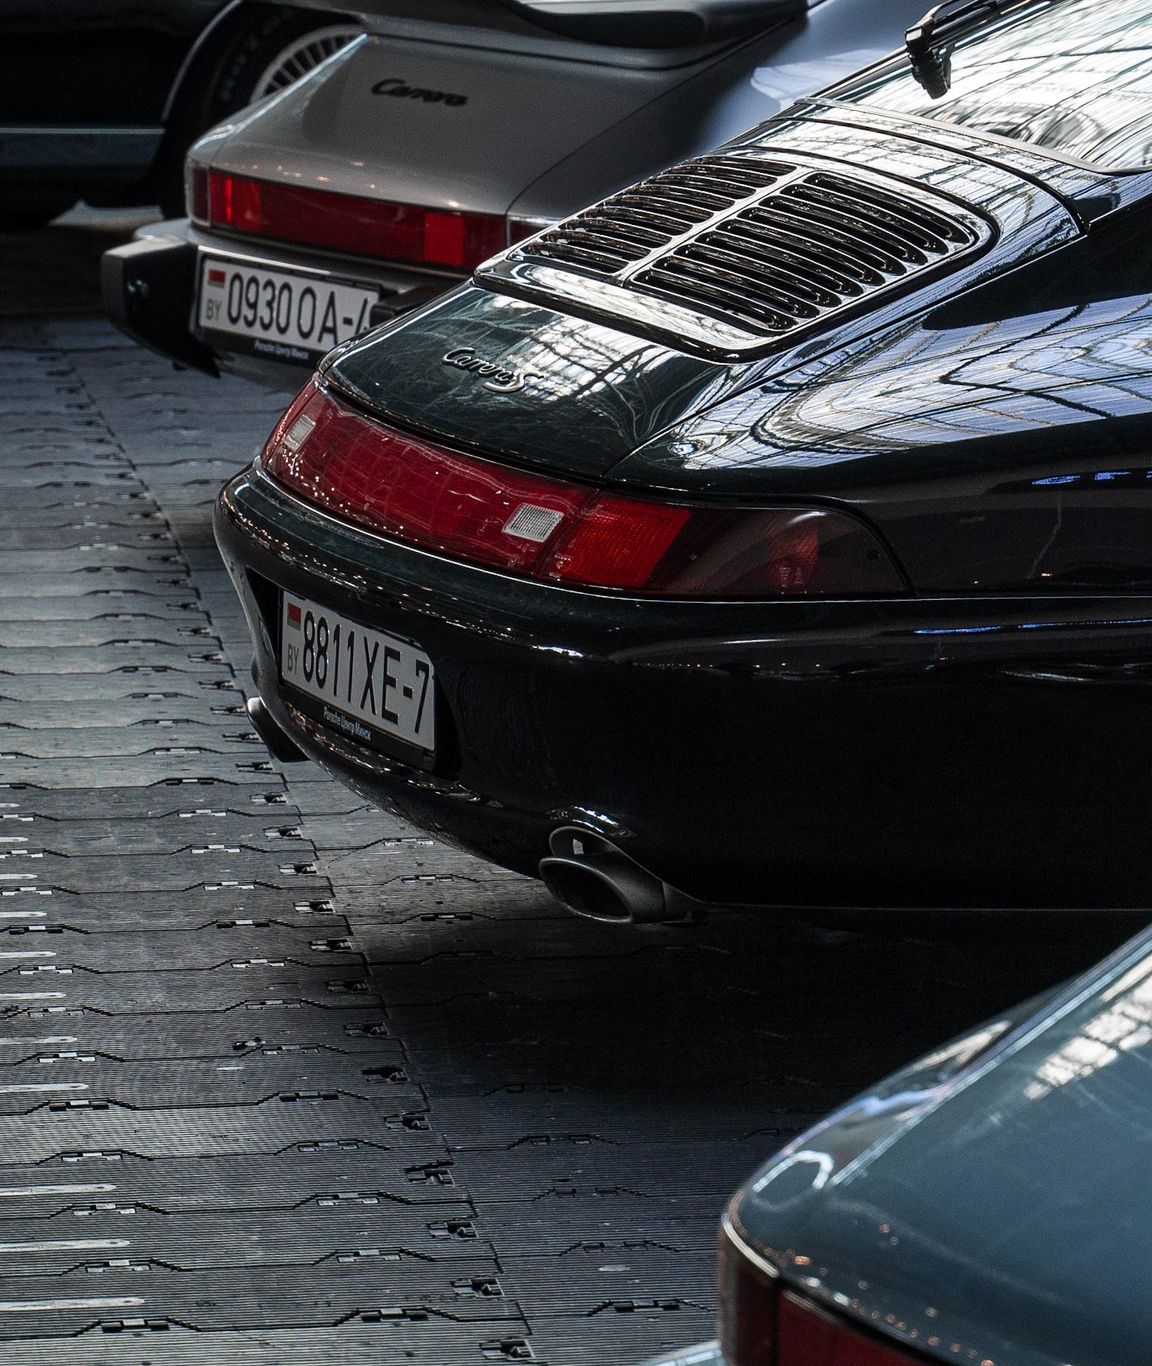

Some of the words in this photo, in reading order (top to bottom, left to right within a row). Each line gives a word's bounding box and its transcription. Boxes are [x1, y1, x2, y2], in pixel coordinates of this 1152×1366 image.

[370, 78, 468, 107] Carrera
[205, 299, 223, 320] BY
[442, 347, 515, 384] Carrera
[482, 372, 544, 393] S
[287, 643, 300, 675] BY
